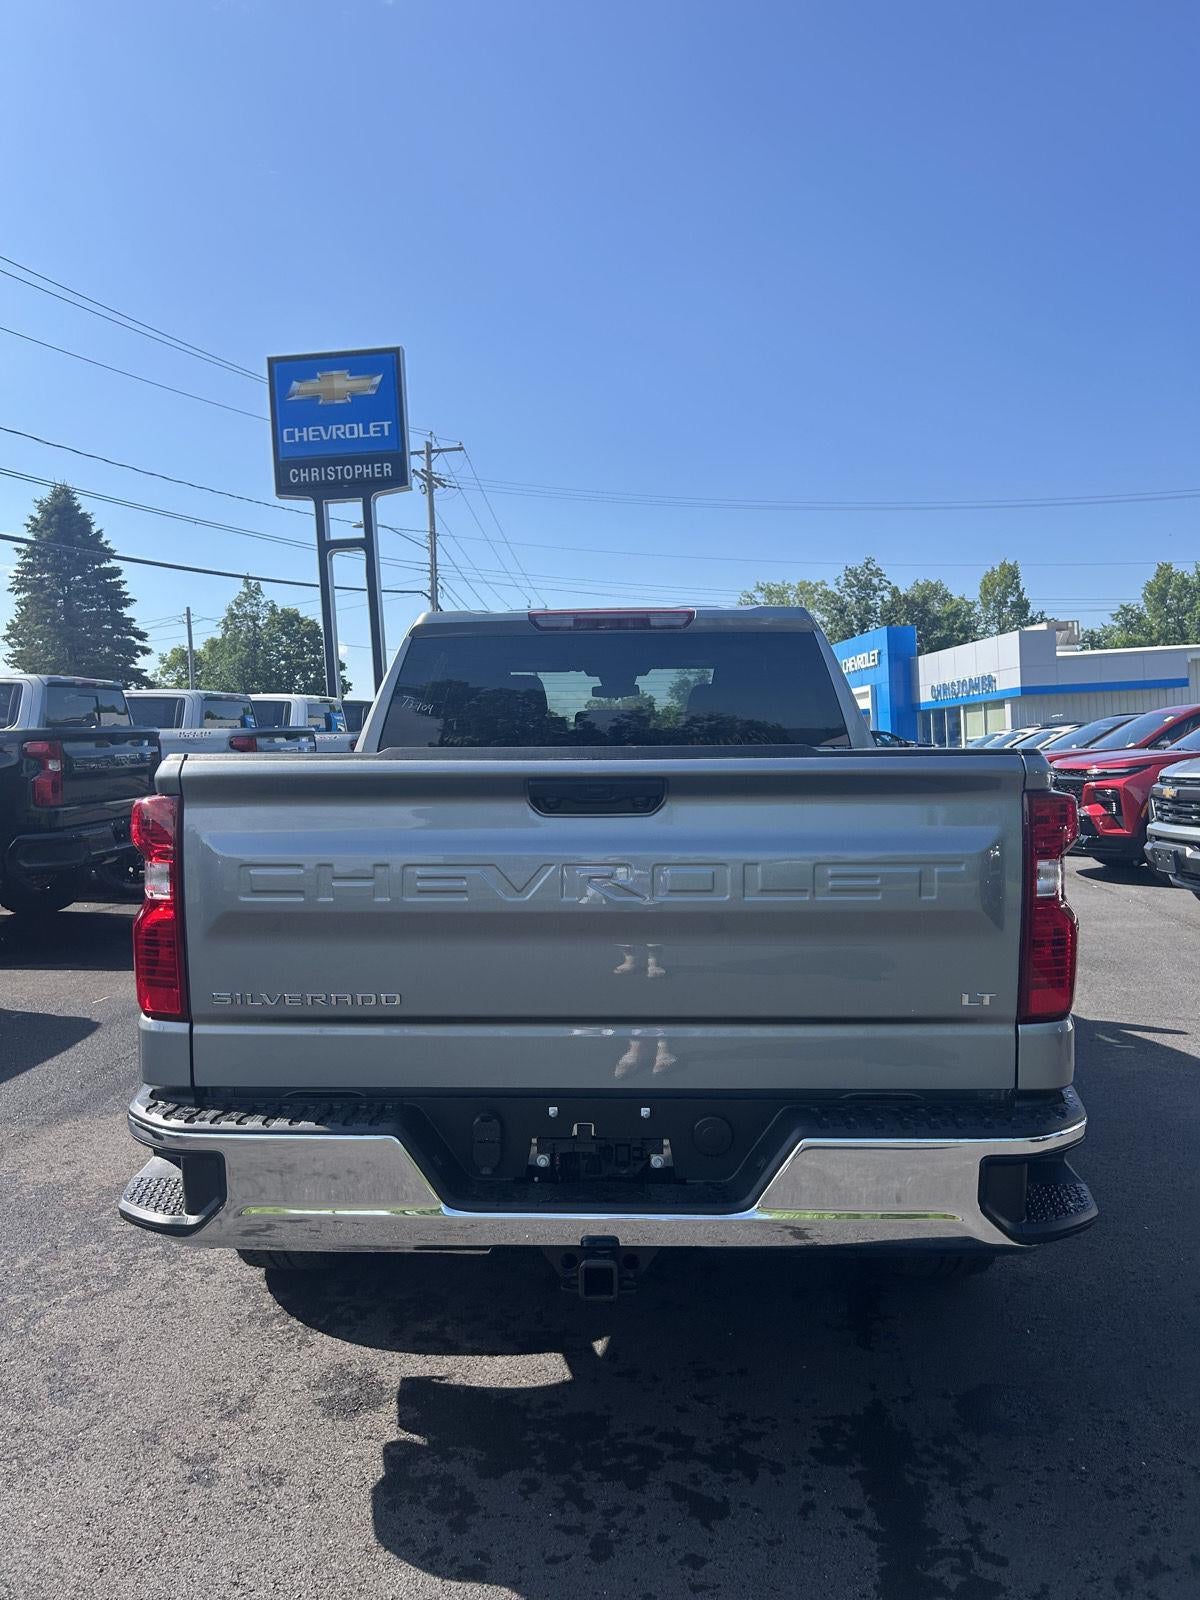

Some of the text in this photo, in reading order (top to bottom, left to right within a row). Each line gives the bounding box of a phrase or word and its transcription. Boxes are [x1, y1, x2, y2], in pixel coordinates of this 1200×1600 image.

[283, 421, 392, 443] CHEVROLET
[289, 463, 392, 483] CHRISTOPHER
[842, 650, 879, 673] CHEVROLET
[931, 675, 996, 701] CHRISTOPHER
[239, 862, 966, 905] CHEVROLET
[212, 992, 402, 1006] SILVERADO
[961, 993, 997, 1006] LT
